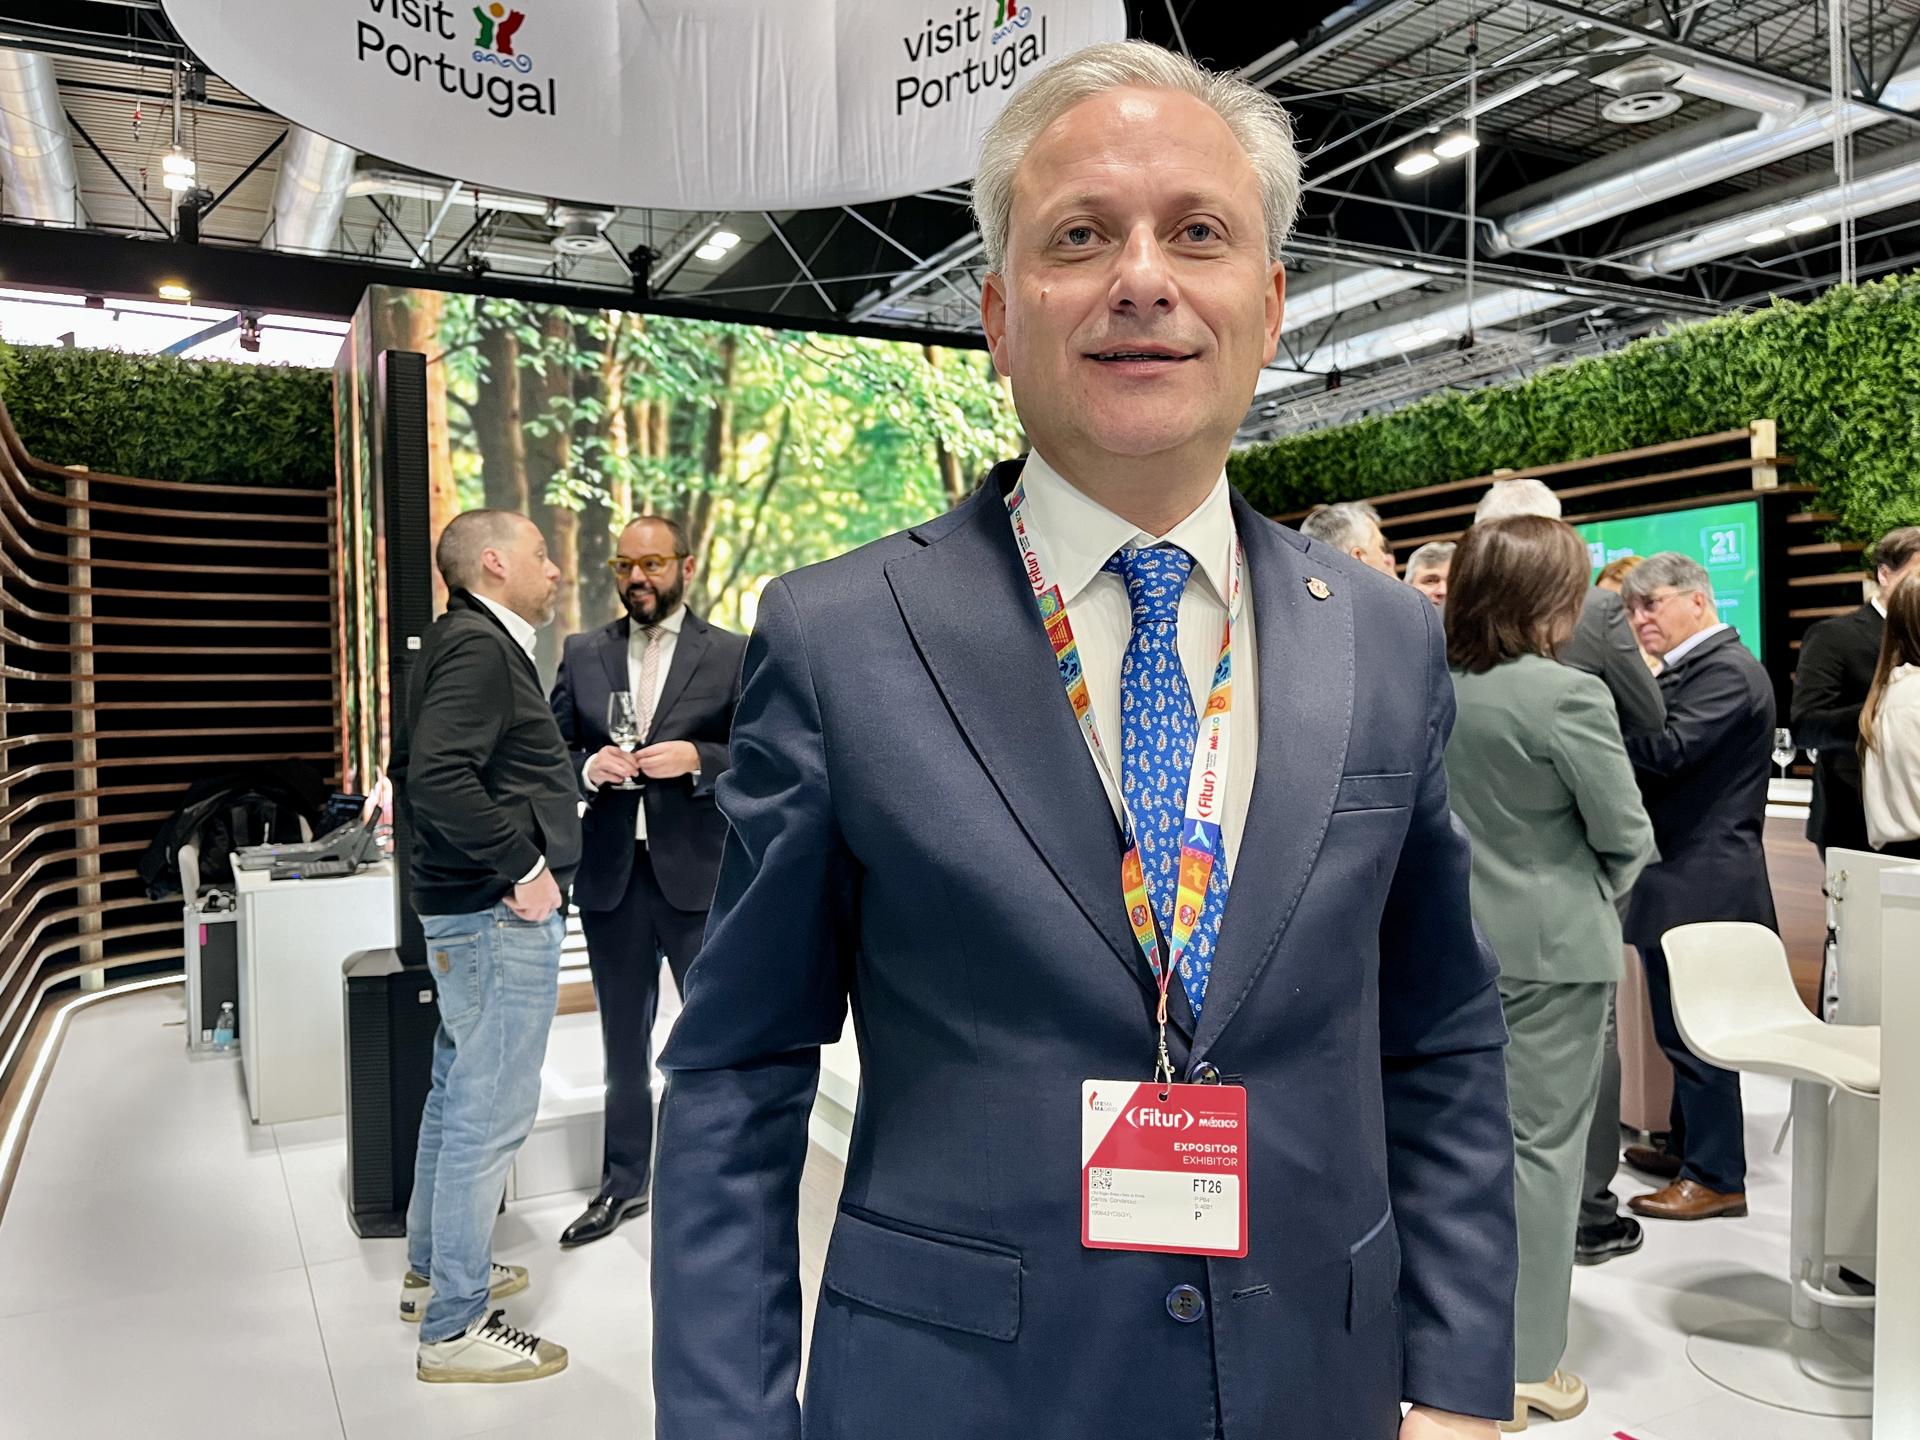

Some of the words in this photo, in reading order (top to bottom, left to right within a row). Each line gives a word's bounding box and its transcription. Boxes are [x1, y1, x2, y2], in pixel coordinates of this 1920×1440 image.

[903, 6, 980, 62] visit
[357, 20, 556, 118] Portugal
[897, 14, 1047, 116] Portugal
[1711, 530, 1736, 554] 21
[1173, 1142, 1238, 1154] EXPOSITOR
[1183, 1155, 1238, 1167] EXHIBITOR
[1193, 1179, 1222, 1194] FT26
[1195, 1211, 1202, 1221] P
